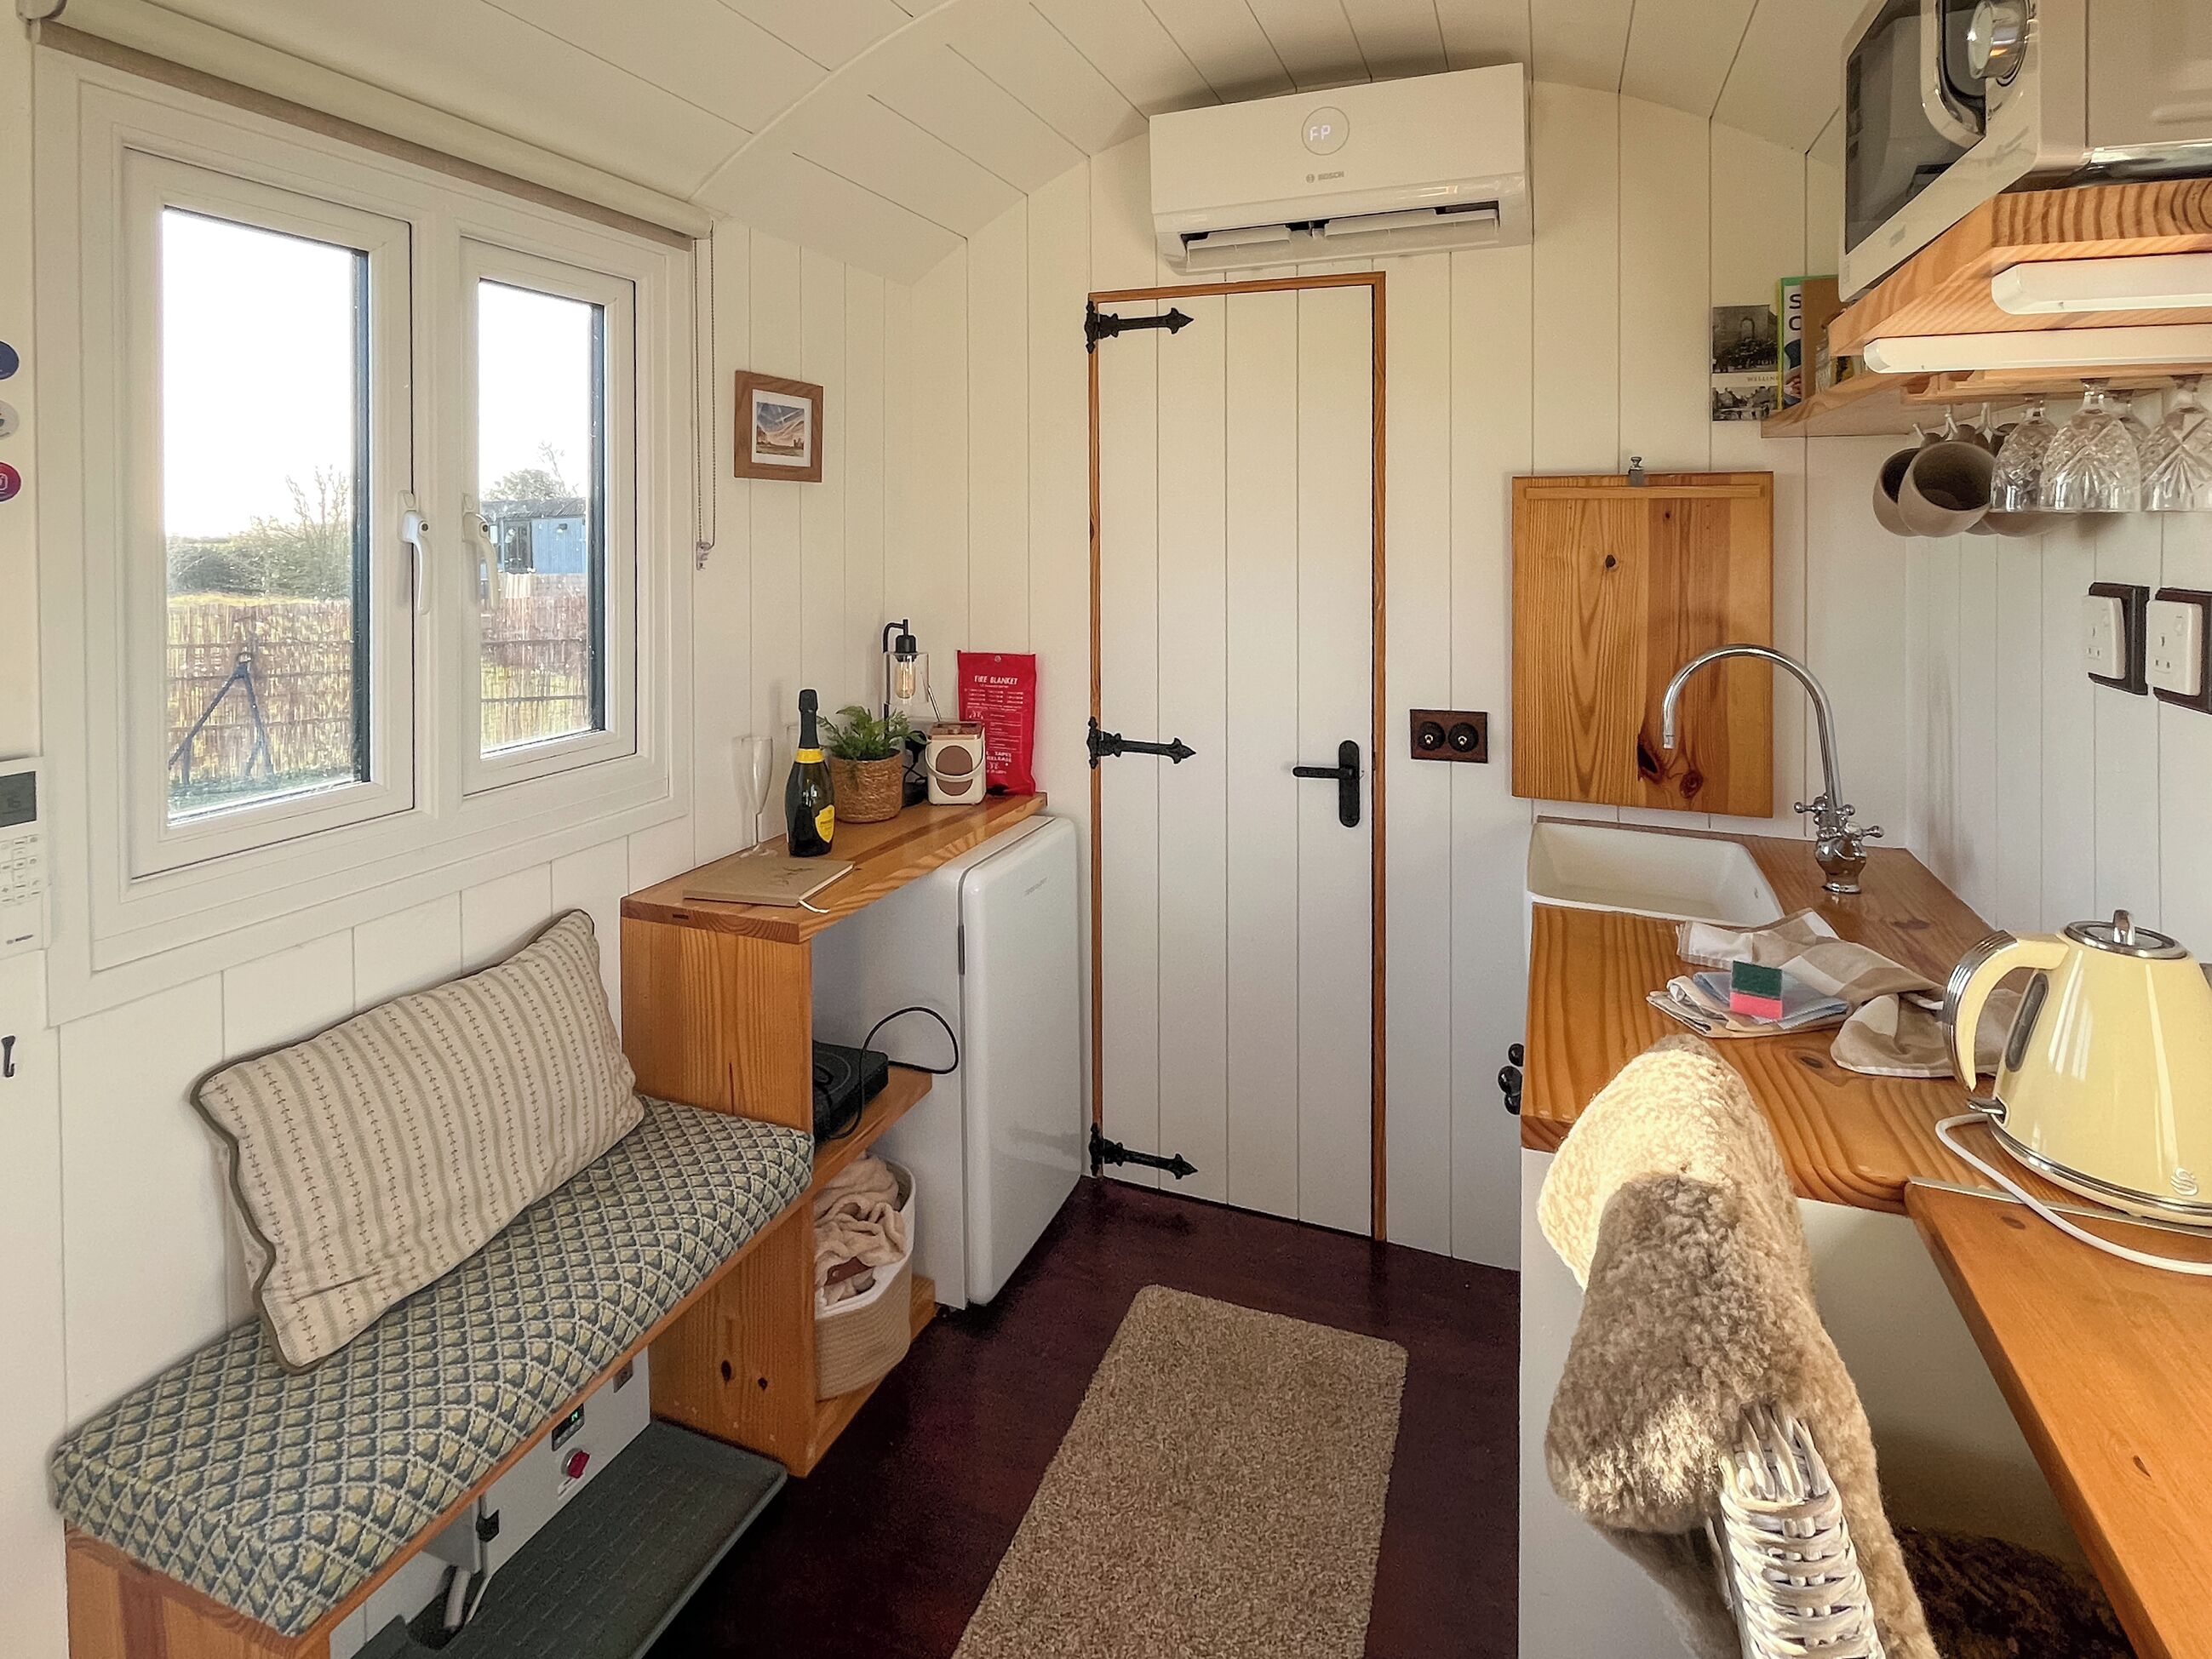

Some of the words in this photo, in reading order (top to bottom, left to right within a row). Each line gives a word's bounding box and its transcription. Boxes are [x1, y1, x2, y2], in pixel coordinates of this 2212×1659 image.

[1309, 124, 1331, 141] FP
[1318, 171, 1344, 180] BOSCH
[989, 676, 1018, 684] BLANKET
